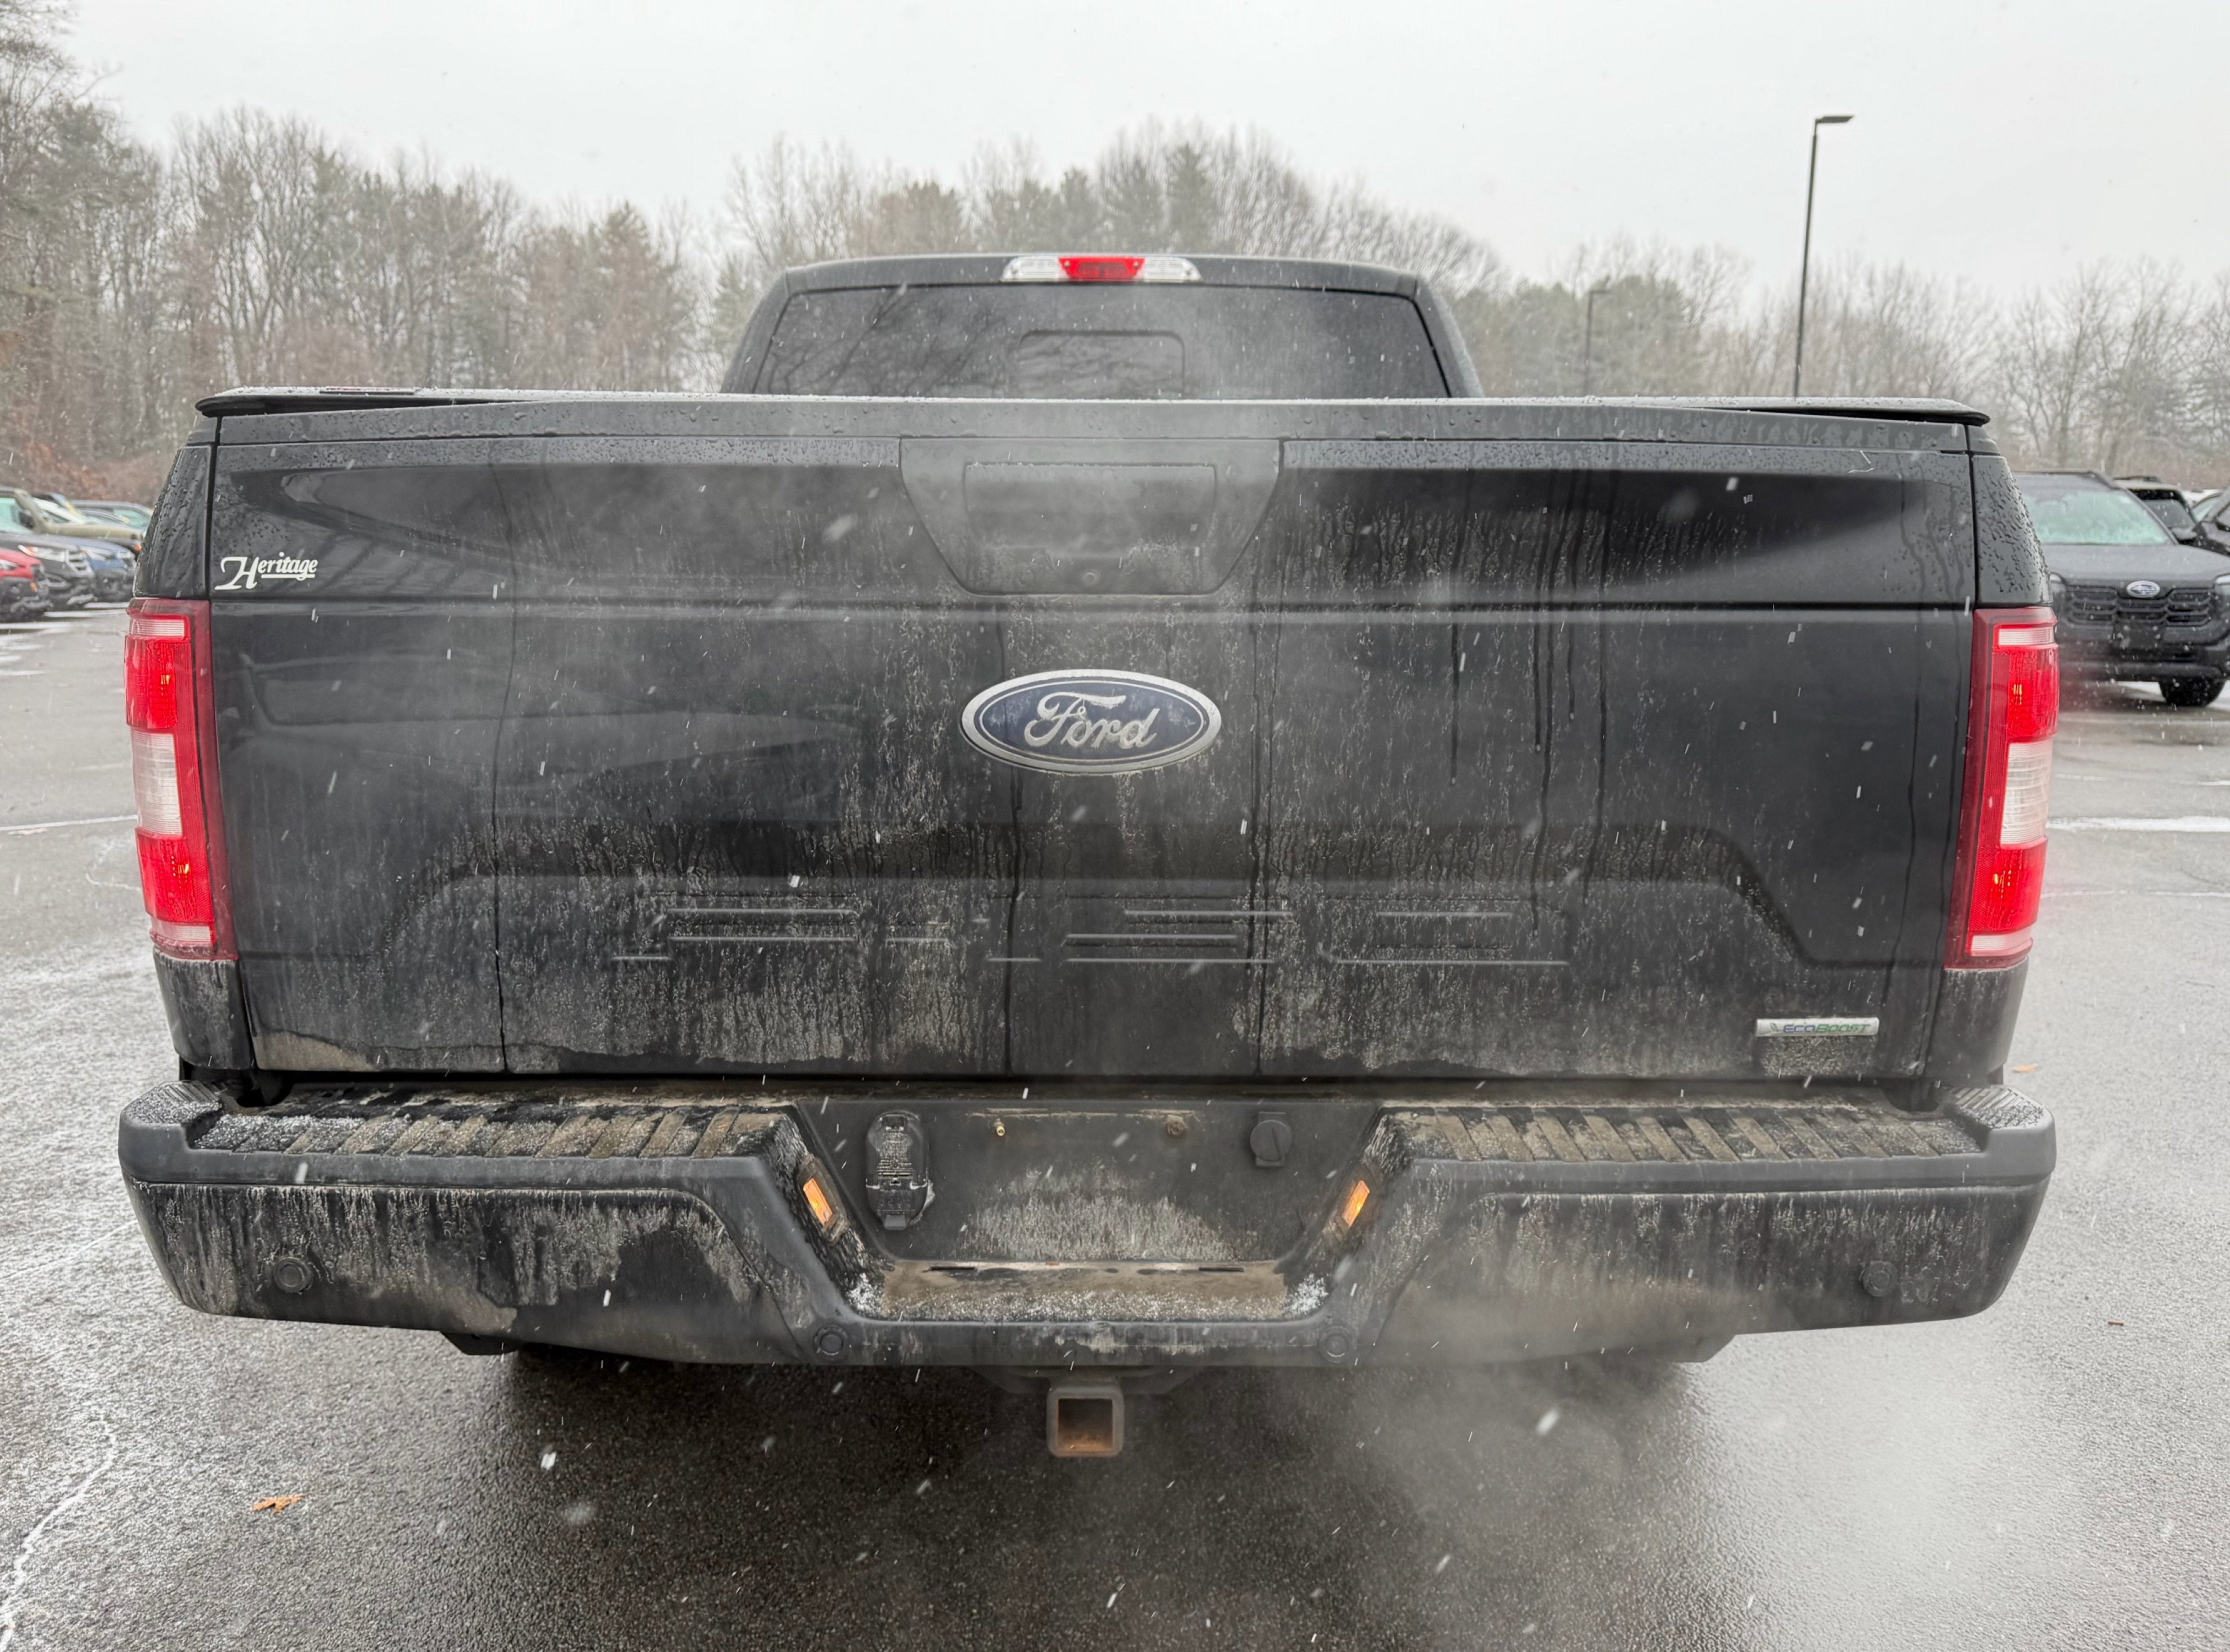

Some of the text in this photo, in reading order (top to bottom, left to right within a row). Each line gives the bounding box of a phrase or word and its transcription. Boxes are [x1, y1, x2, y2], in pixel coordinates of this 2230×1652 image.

[214, 552, 318, 590] Heritage
[1024, 692, 1160, 749] Ford
[1783, 1024, 1870, 1033] ECOBOOST
